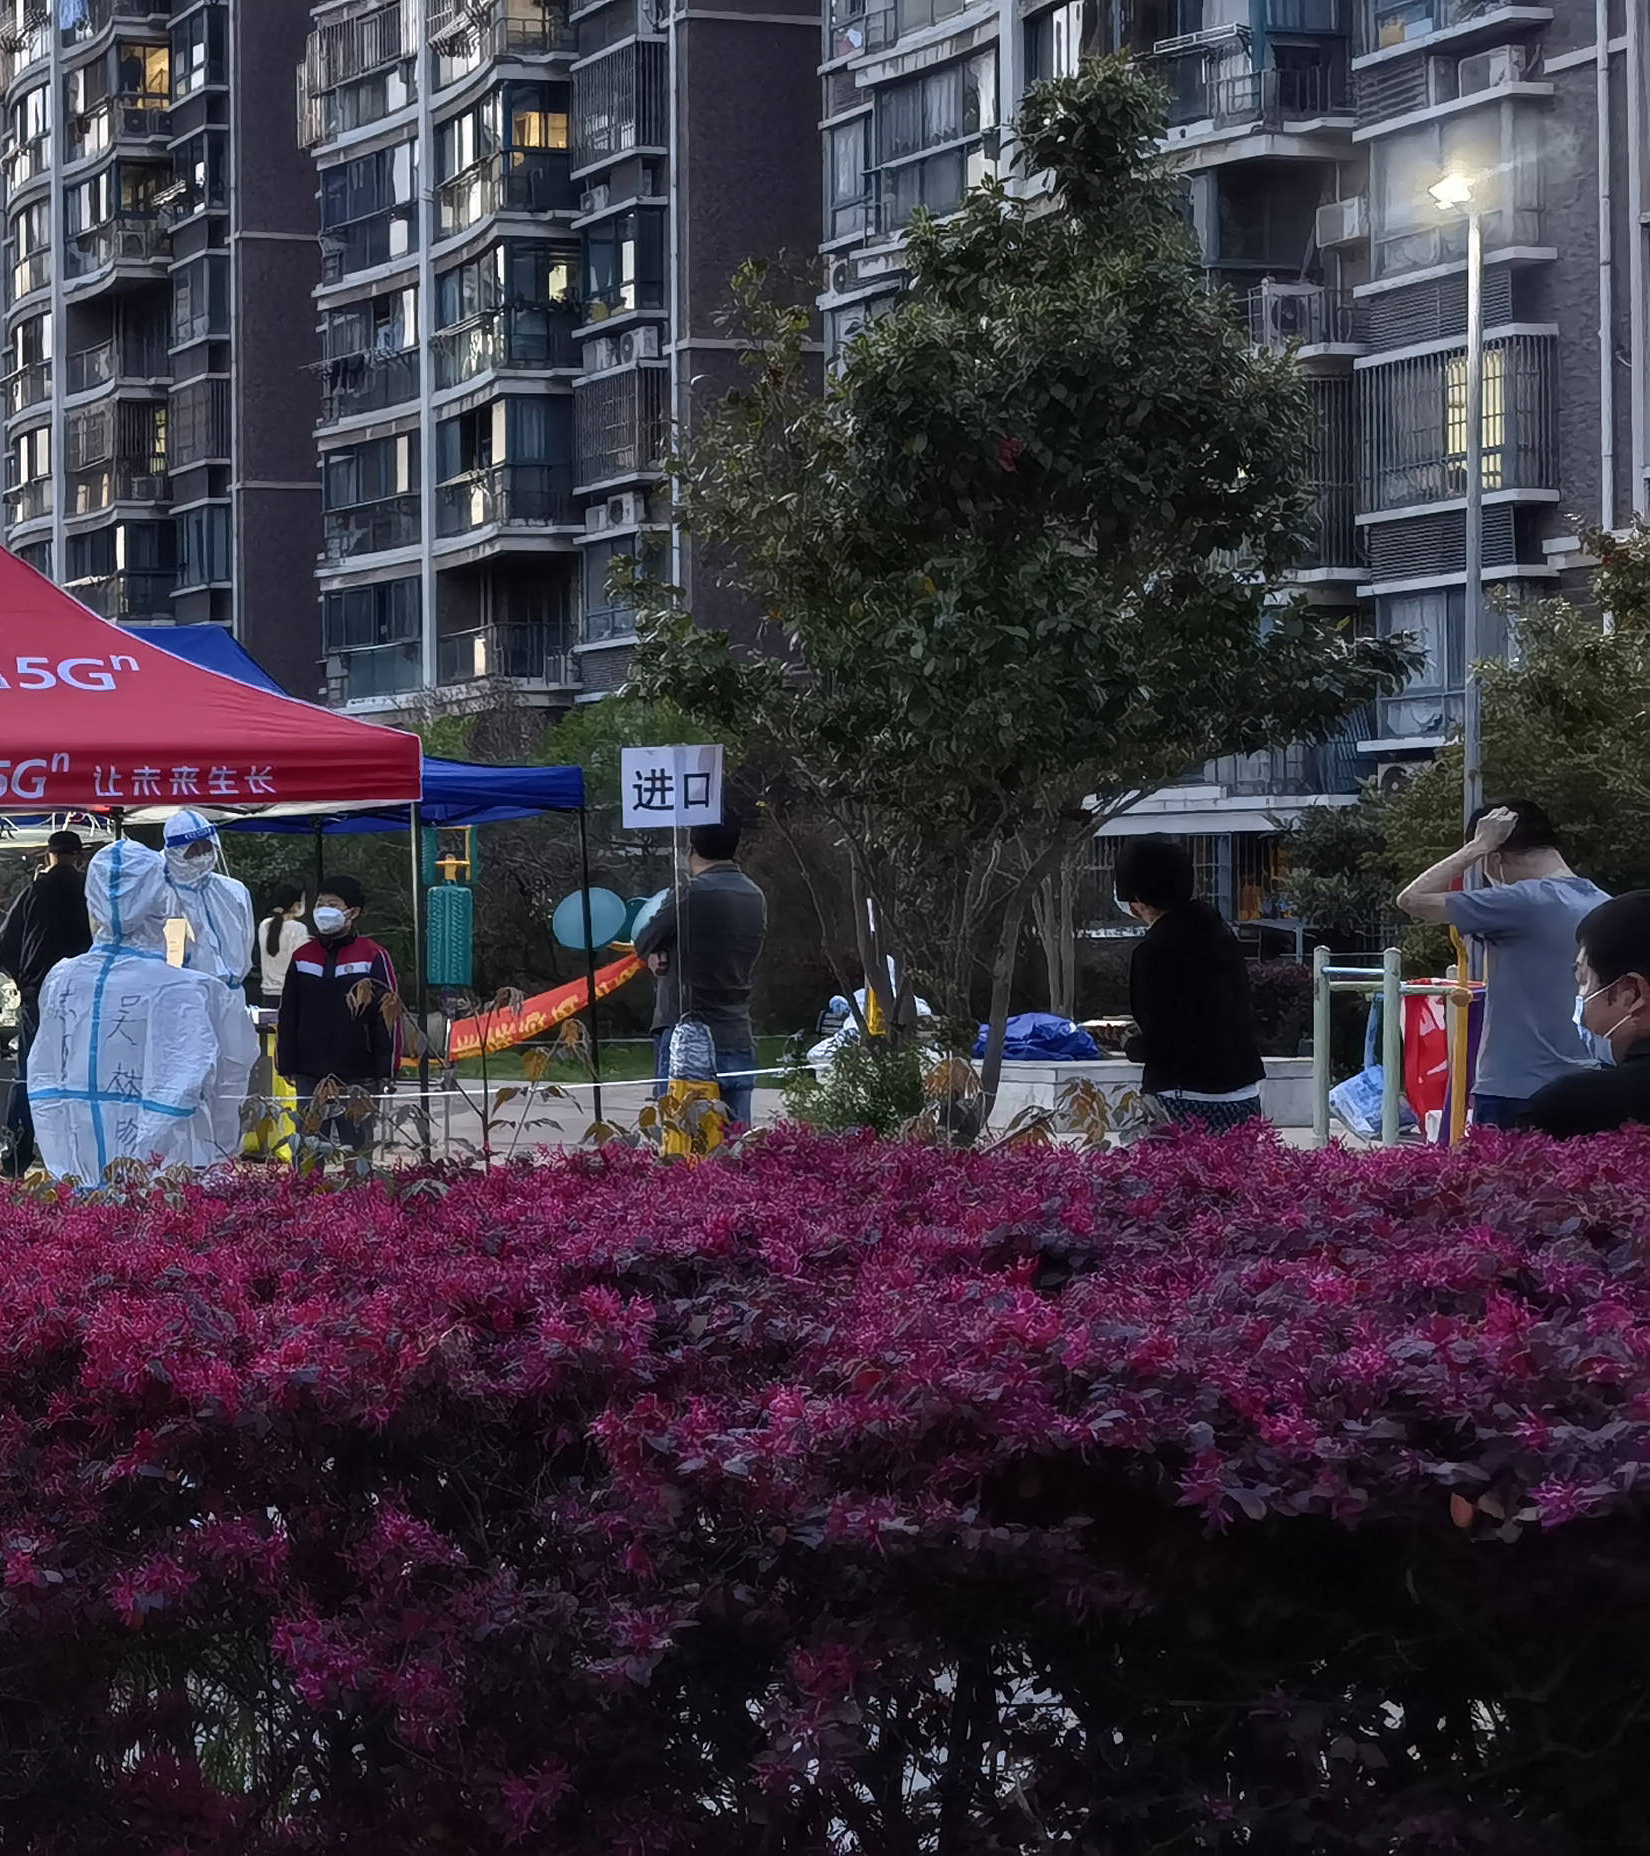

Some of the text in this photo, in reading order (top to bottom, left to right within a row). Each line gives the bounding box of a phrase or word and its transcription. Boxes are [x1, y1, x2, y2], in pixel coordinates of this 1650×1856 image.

[93, 765, 277, 797] 让未来生长
[632, 768, 710, 811] 进口
